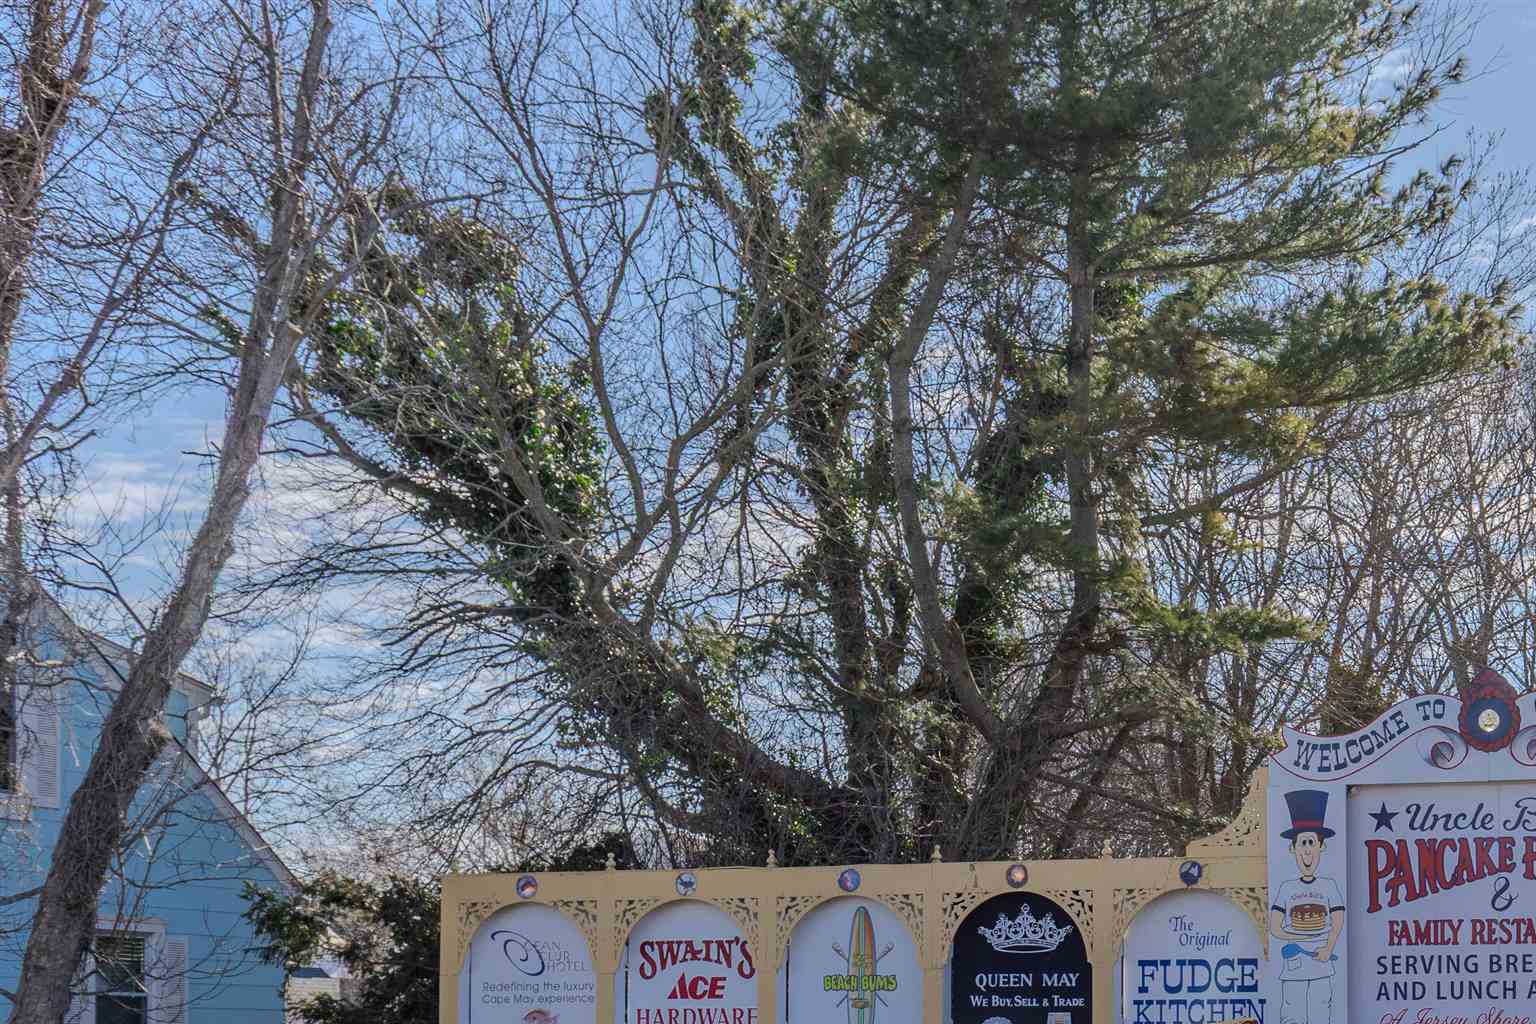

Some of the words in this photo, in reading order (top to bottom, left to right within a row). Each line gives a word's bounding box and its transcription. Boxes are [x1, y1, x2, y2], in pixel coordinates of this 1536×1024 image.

[1293, 712, 1412, 773] WELCOME
[1417, 700, 1445, 720] TO
[1405, 801, 1495, 832] Uncle
[1365, 836, 1516, 914] PANCAKE
[1491, 876, 1519, 912] &
[1169, 914, 1194, 932] The
[1387, 918, 1464, 946] FAMILY
[1179, 930, 1232, 950] Original
[639, 936, 756, 980] SWAIN'S
[1377, 954, 1479, 975] SERVING
[482, 982, 540, 993] Redefining
[543, 981, 560, 991] the
[564, 982, 595, 993] luxury
[666, 972, 727, 999] ACE
[824, 975, 857, 991] BEACH
[861, 975, 897, 992] BUMS
[975, 973, 1033, 991] QUEEN
[1042, 973, 1080, 987] MAY
[1137, 958, 1258, 994] FUDGE
[1376, 981, 1427, 1001] AND
[1436, 980, 1517, 1000] LUNCH
